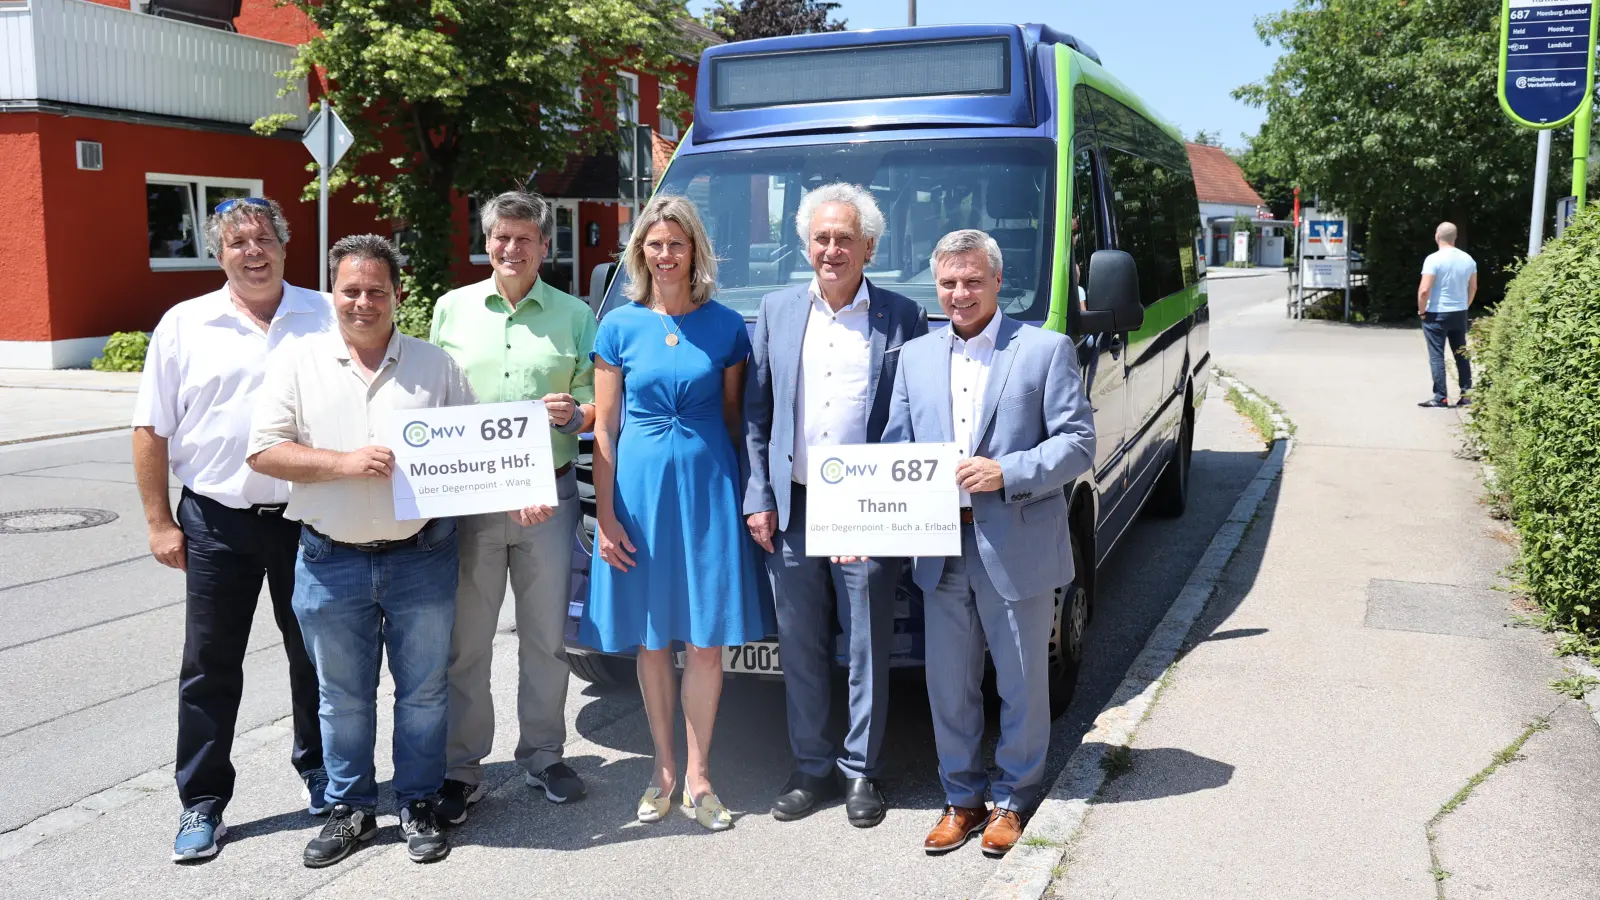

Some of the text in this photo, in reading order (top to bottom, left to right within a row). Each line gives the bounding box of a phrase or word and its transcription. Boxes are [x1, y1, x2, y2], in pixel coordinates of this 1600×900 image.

[1510, 10, 1530, 20] 687
[431, 416, 529, 441] MVV 687
[410, 454, 535, 477] Moosburg Hbf.
[845, 459, 939, 482] MVV 687
[418, 486, 439, 495] über
[442, 481, 498, 494] Degernpoint
[505, 478, 531, 488] Wang
[857, 498, 907, 513] Thann
[810, 523, 829, 532] über
[831, 523, 884, 534] Degernpoint
[891, 522, 913, 532] Buch
[925, 522, 957, 532] Erlbach
